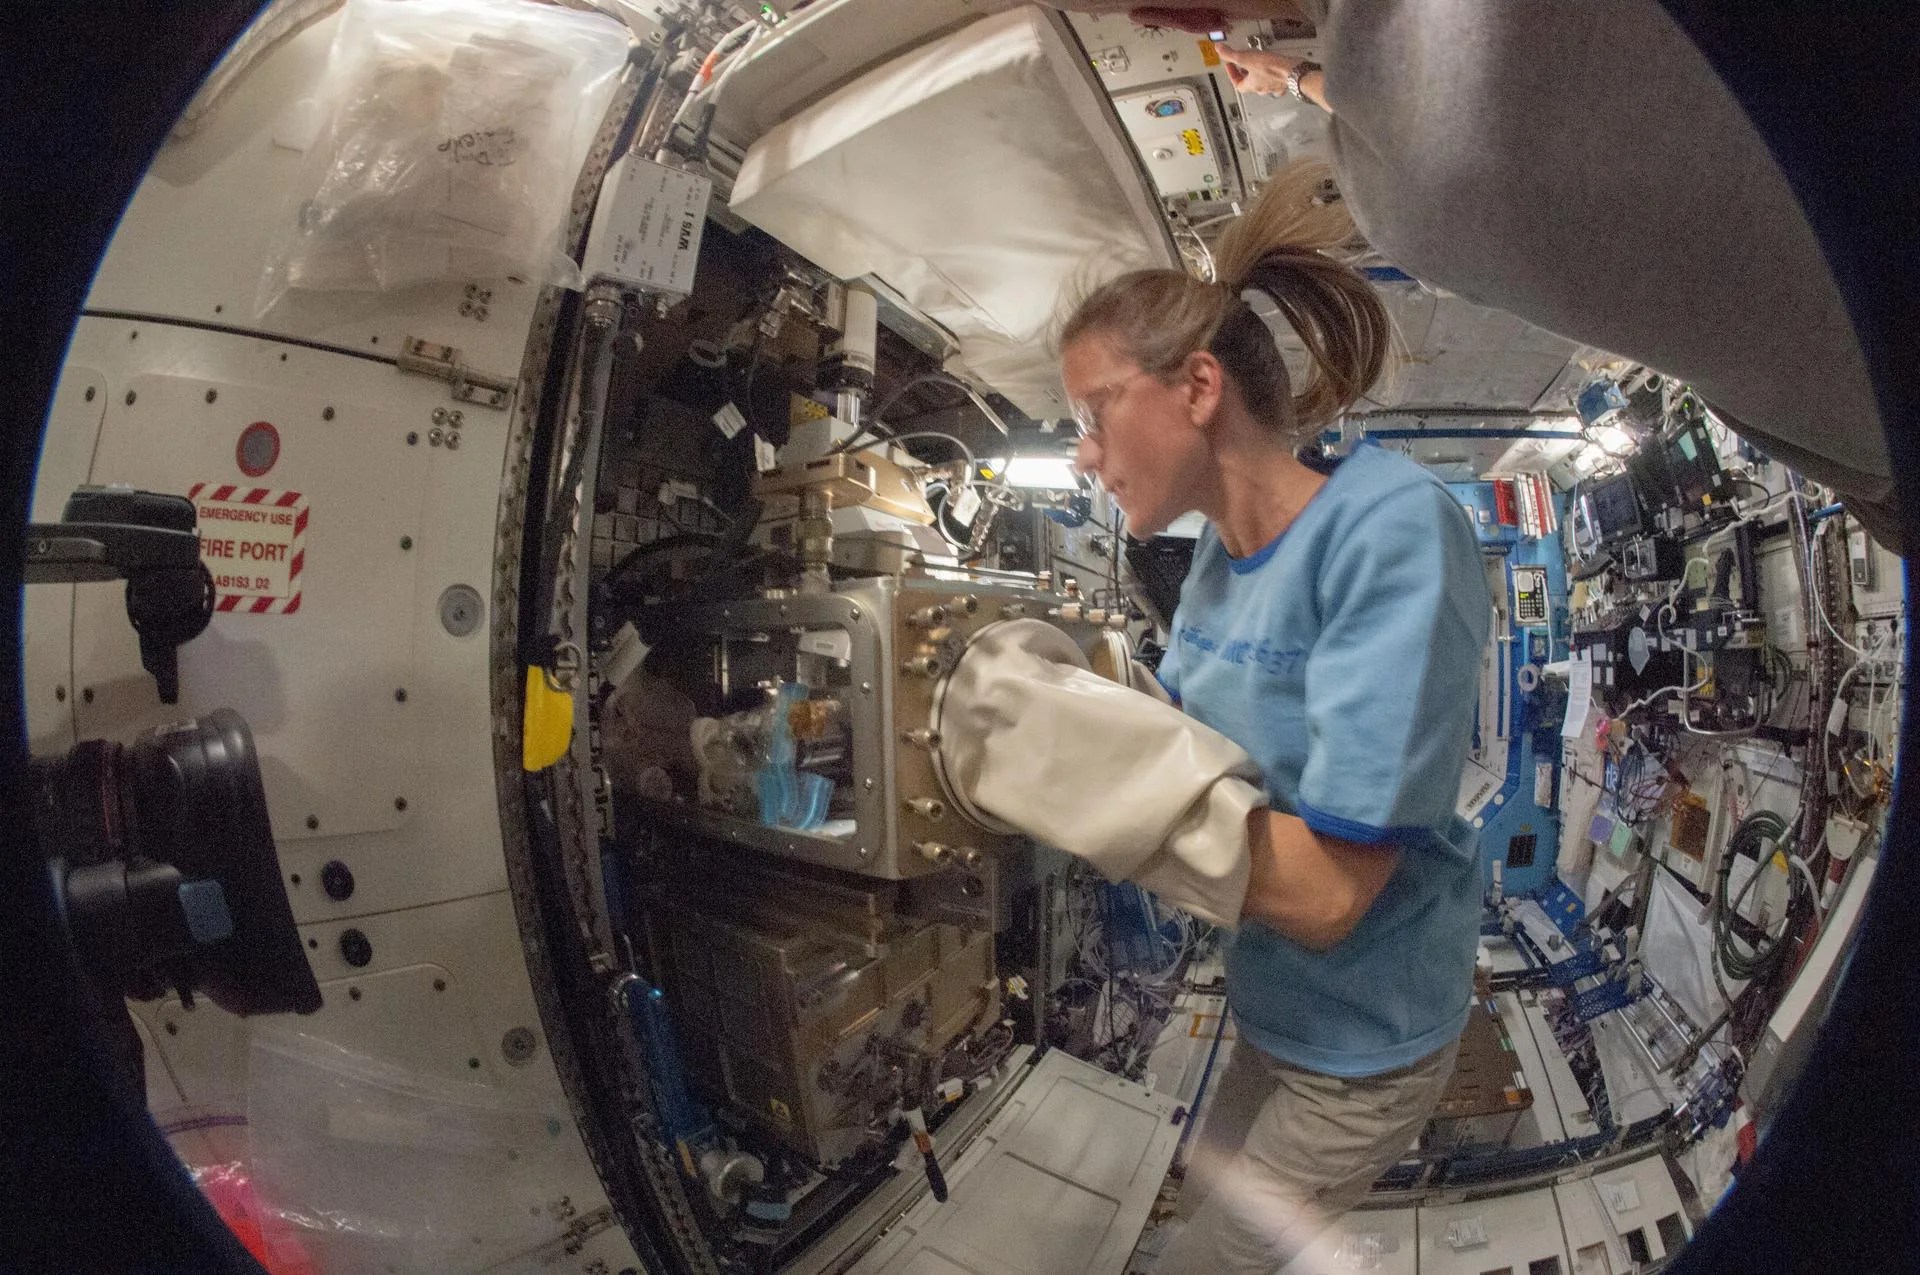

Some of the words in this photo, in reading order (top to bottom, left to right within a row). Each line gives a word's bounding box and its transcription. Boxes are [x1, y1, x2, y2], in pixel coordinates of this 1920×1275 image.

[200, 507, 268, 522] EMERGENCY
[271, 514, 293, 525] USE
[240, 541, 289, 561] PORT
